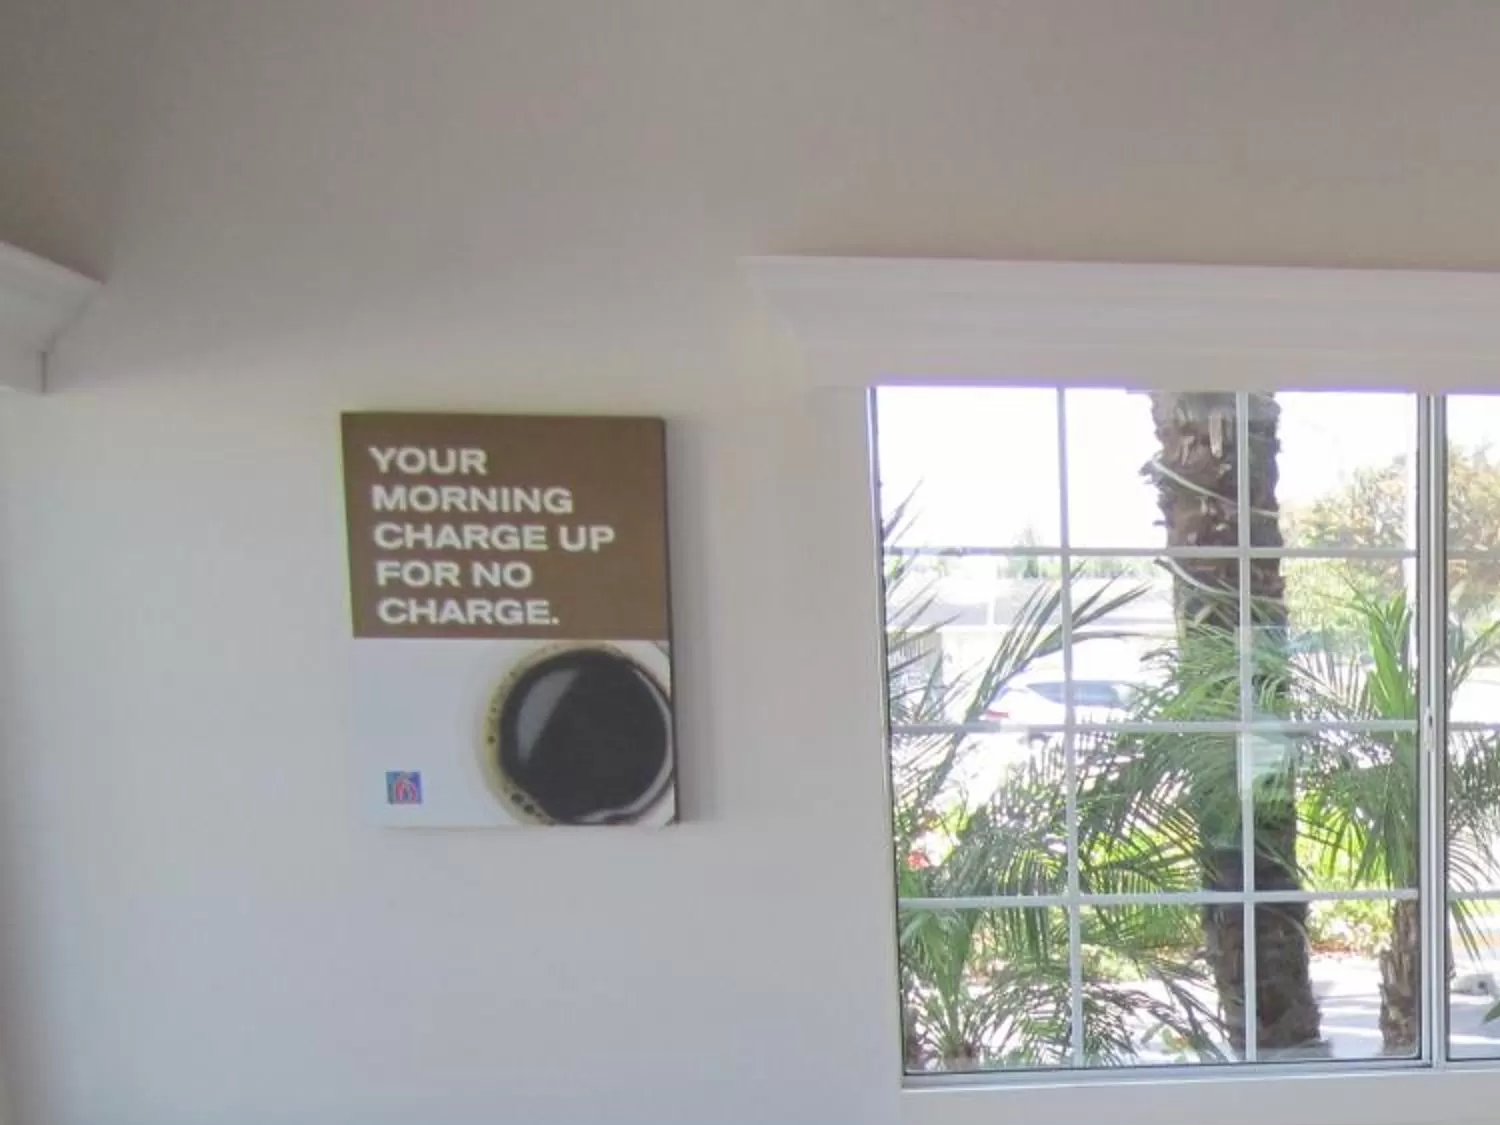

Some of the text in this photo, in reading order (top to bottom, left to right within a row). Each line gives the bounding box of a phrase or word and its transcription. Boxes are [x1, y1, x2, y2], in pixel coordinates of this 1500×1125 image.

[368, 446, 488, 475] YOUR
[371, 485, 574, 513] MORNING
[373, 522, 616, 552] CHARGE UP
[375, 560, 533, 588] FOR NO
[377, 598, 561, 626] CHARGE.
